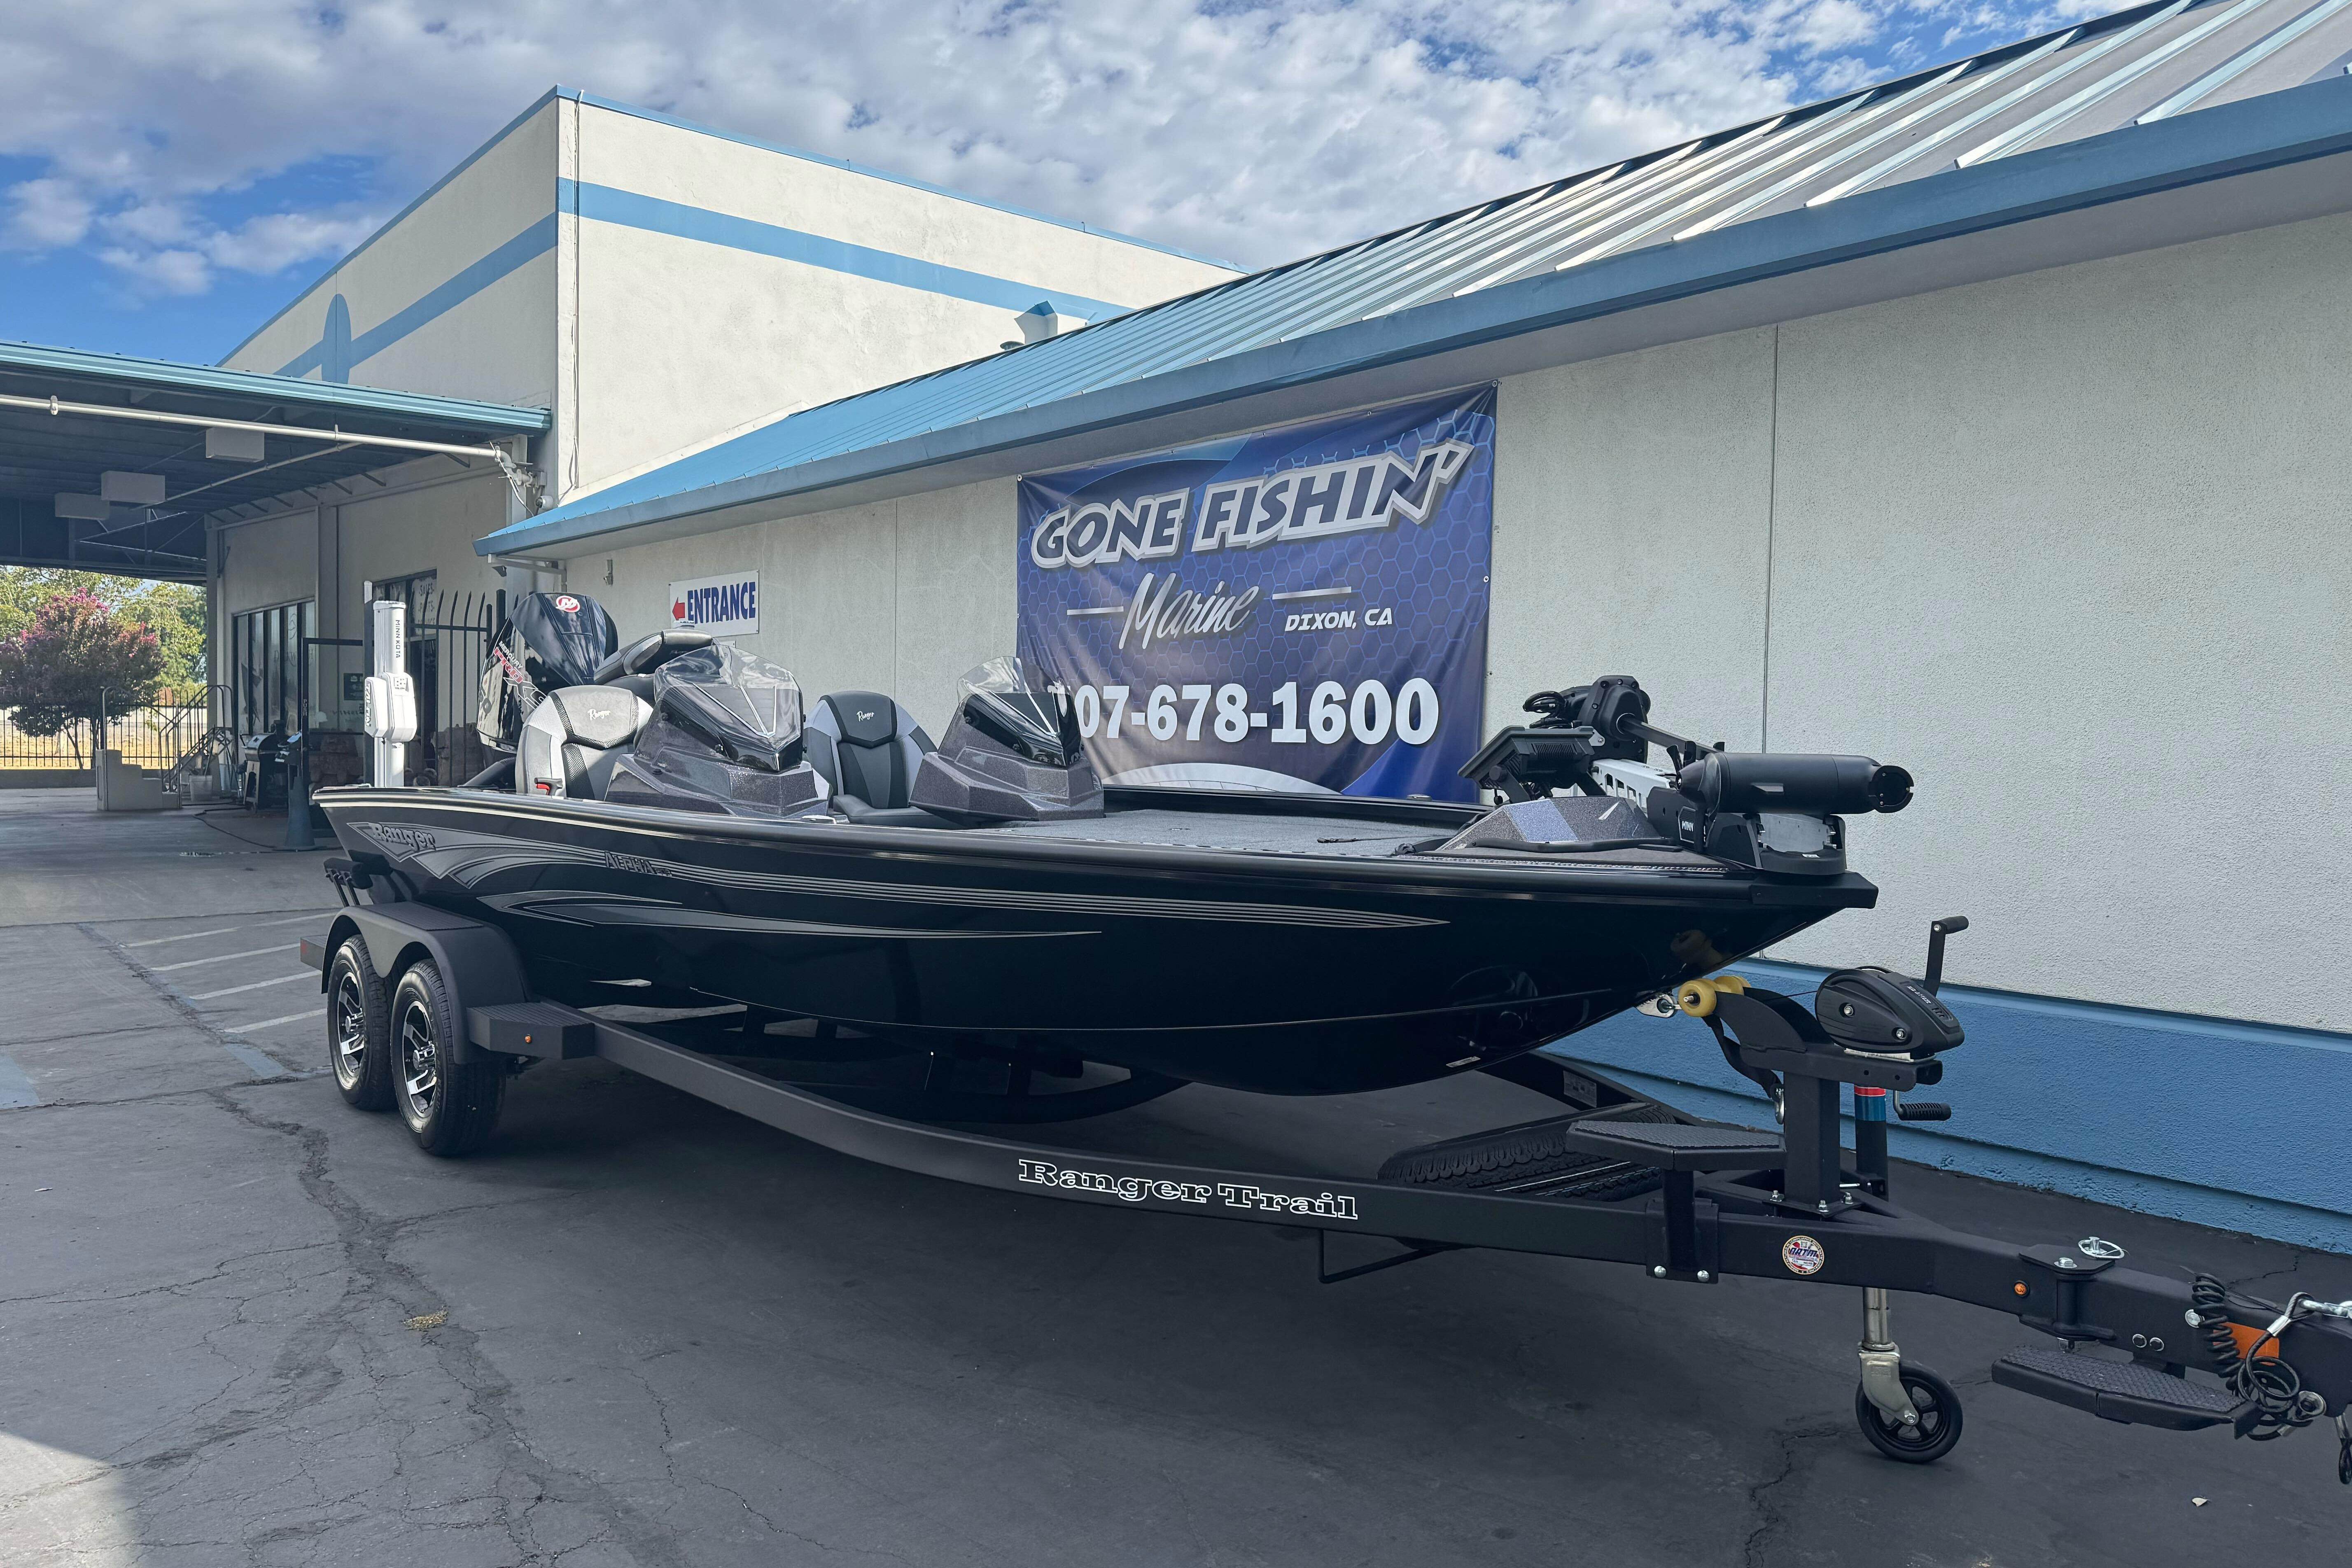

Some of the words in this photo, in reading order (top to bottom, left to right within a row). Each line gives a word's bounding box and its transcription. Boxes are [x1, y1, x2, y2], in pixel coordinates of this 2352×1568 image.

[1031, 487, 1190, 568] GONE
[687, 582, 756, 625] ENTRANCE
[1119, 573, 1260, 650] Marine
[1284, 610, 1358, 632] DIXON,
[1365, 607, 1393, 626] CA
[499, 641, 524, 669] MERCURY
[369, 823, 436, 852] Ranger
[1682, 820, 1694, 832] MINN
[1018, 1159, 1211, 1203] Ranger
[1217, 1183, 1358, 1220] Trail
